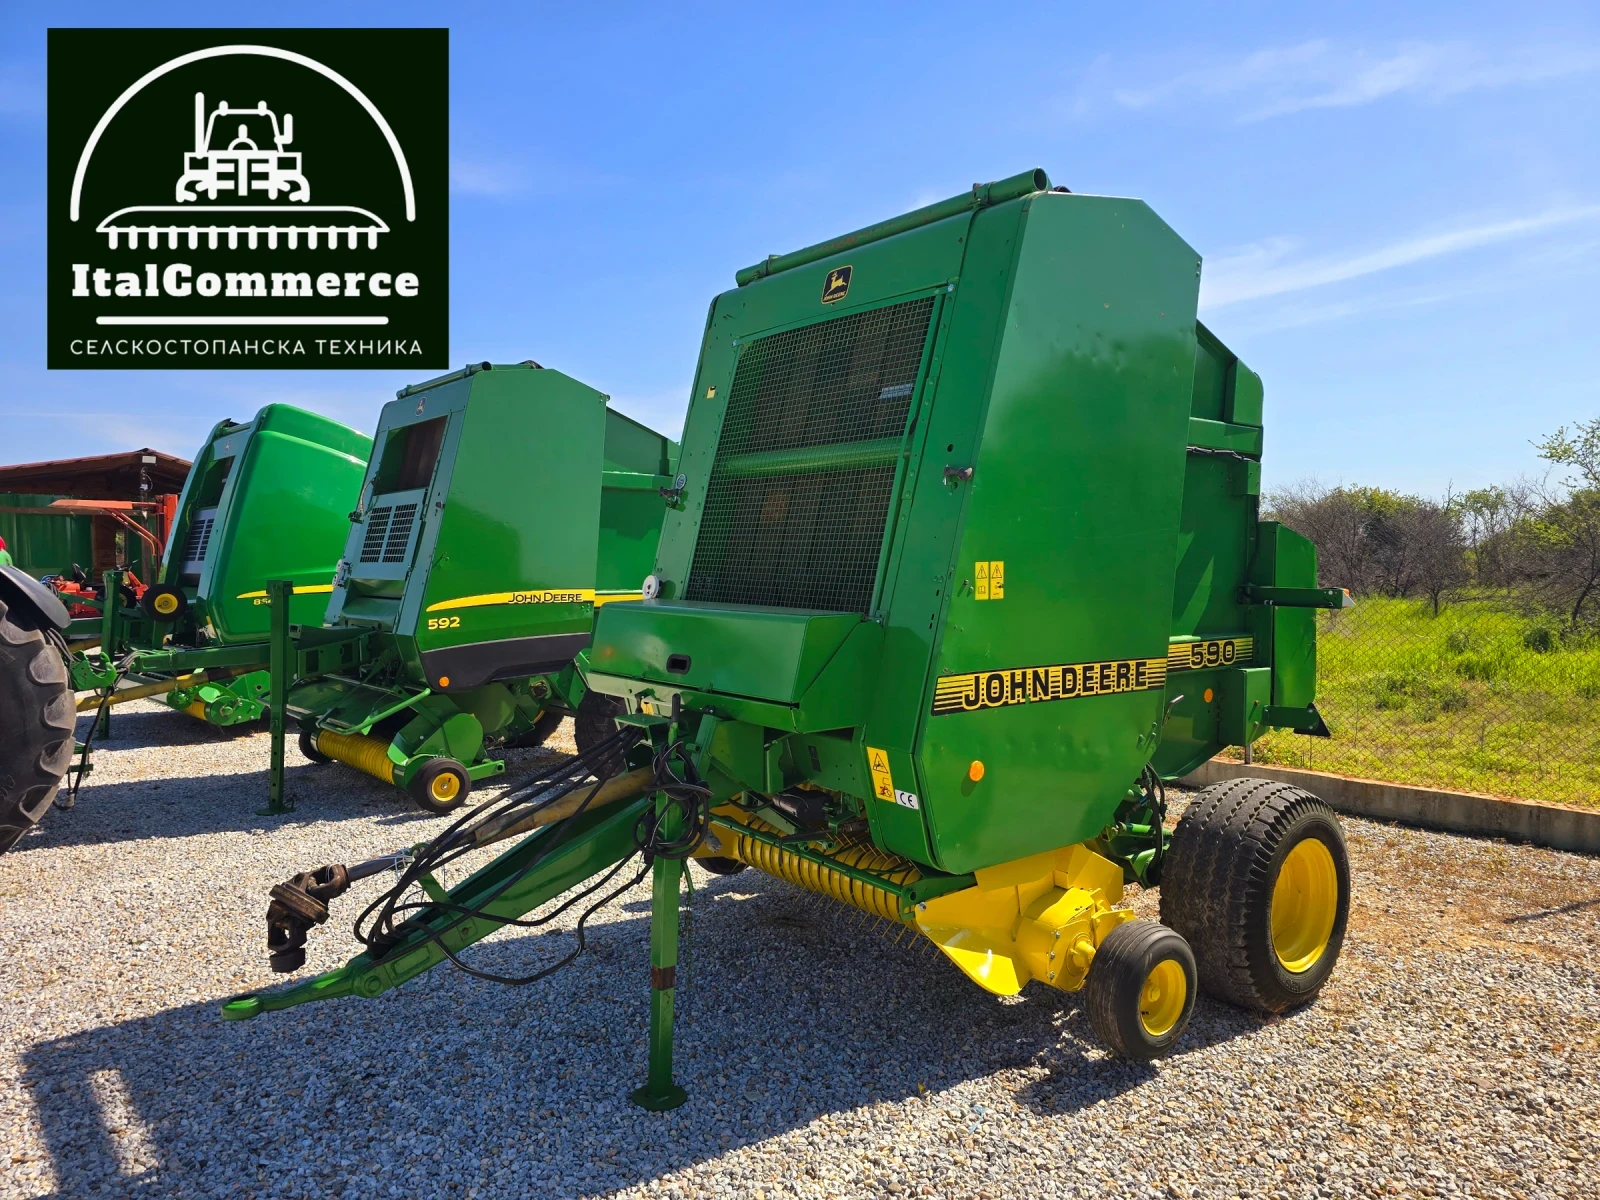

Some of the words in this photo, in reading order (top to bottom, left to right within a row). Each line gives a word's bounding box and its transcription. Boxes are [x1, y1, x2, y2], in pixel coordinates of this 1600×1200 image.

[508, 592, 542, 604] JOHN
[543, 592, 583, 603] DEERE
[428, 616, 460, 630] 592
[1189, 640, 1236, 669] 590
[962, 668, 1050, 710] JOHN
[1059, 661, 1149, 699] DEERE
[900, 792, 914, 808] CE
